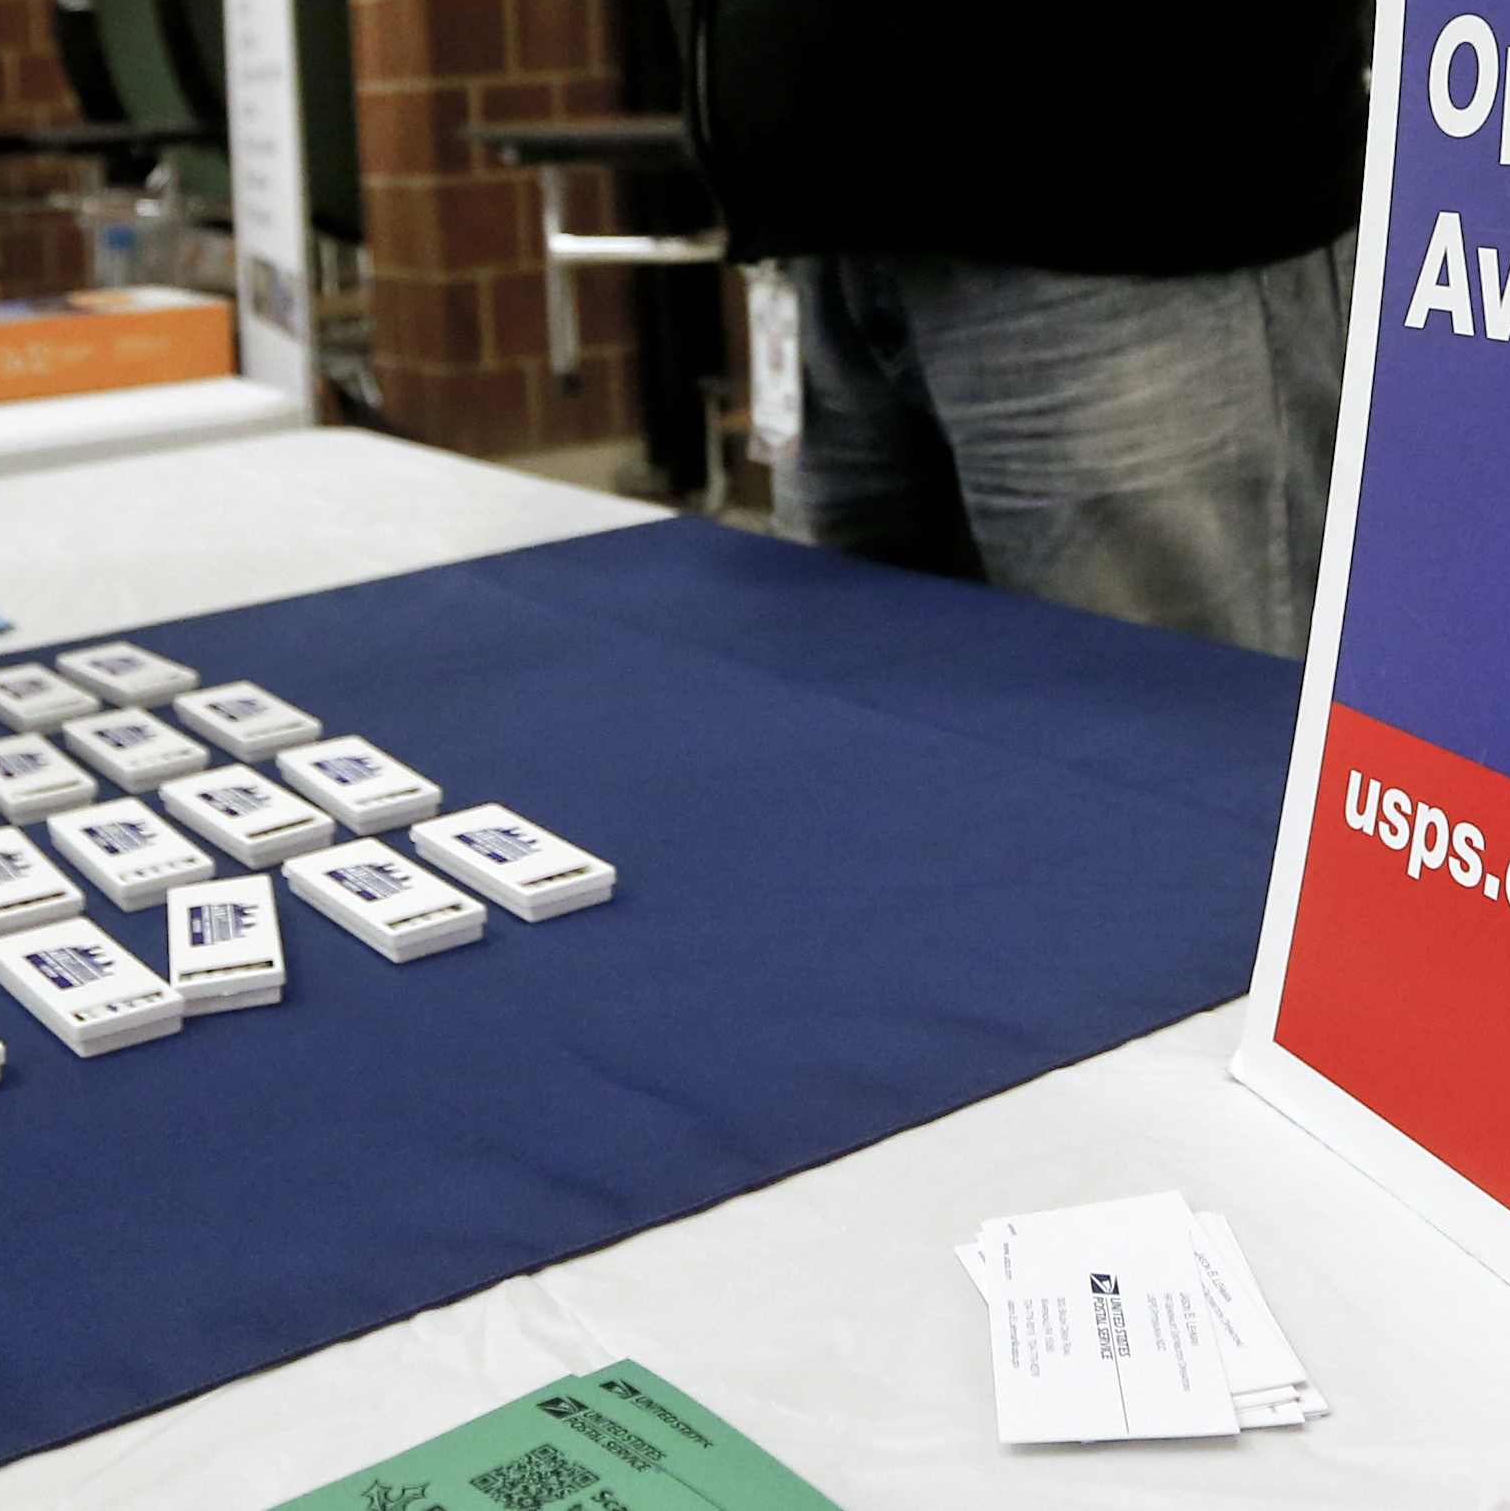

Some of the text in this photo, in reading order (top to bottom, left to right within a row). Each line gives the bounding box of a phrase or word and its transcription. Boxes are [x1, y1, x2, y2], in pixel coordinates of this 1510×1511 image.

[1092, 1296, 1114, 1361] POSTAL SERVICE
[1110, 1297, 1132, 1358] UNITED STATES
[582, 1410, 667, 1462] UNITED STATES
[635, 1395, 678, 1426] UNITED
[564, 1416, 653, 1473] POSTAL SERVICE
